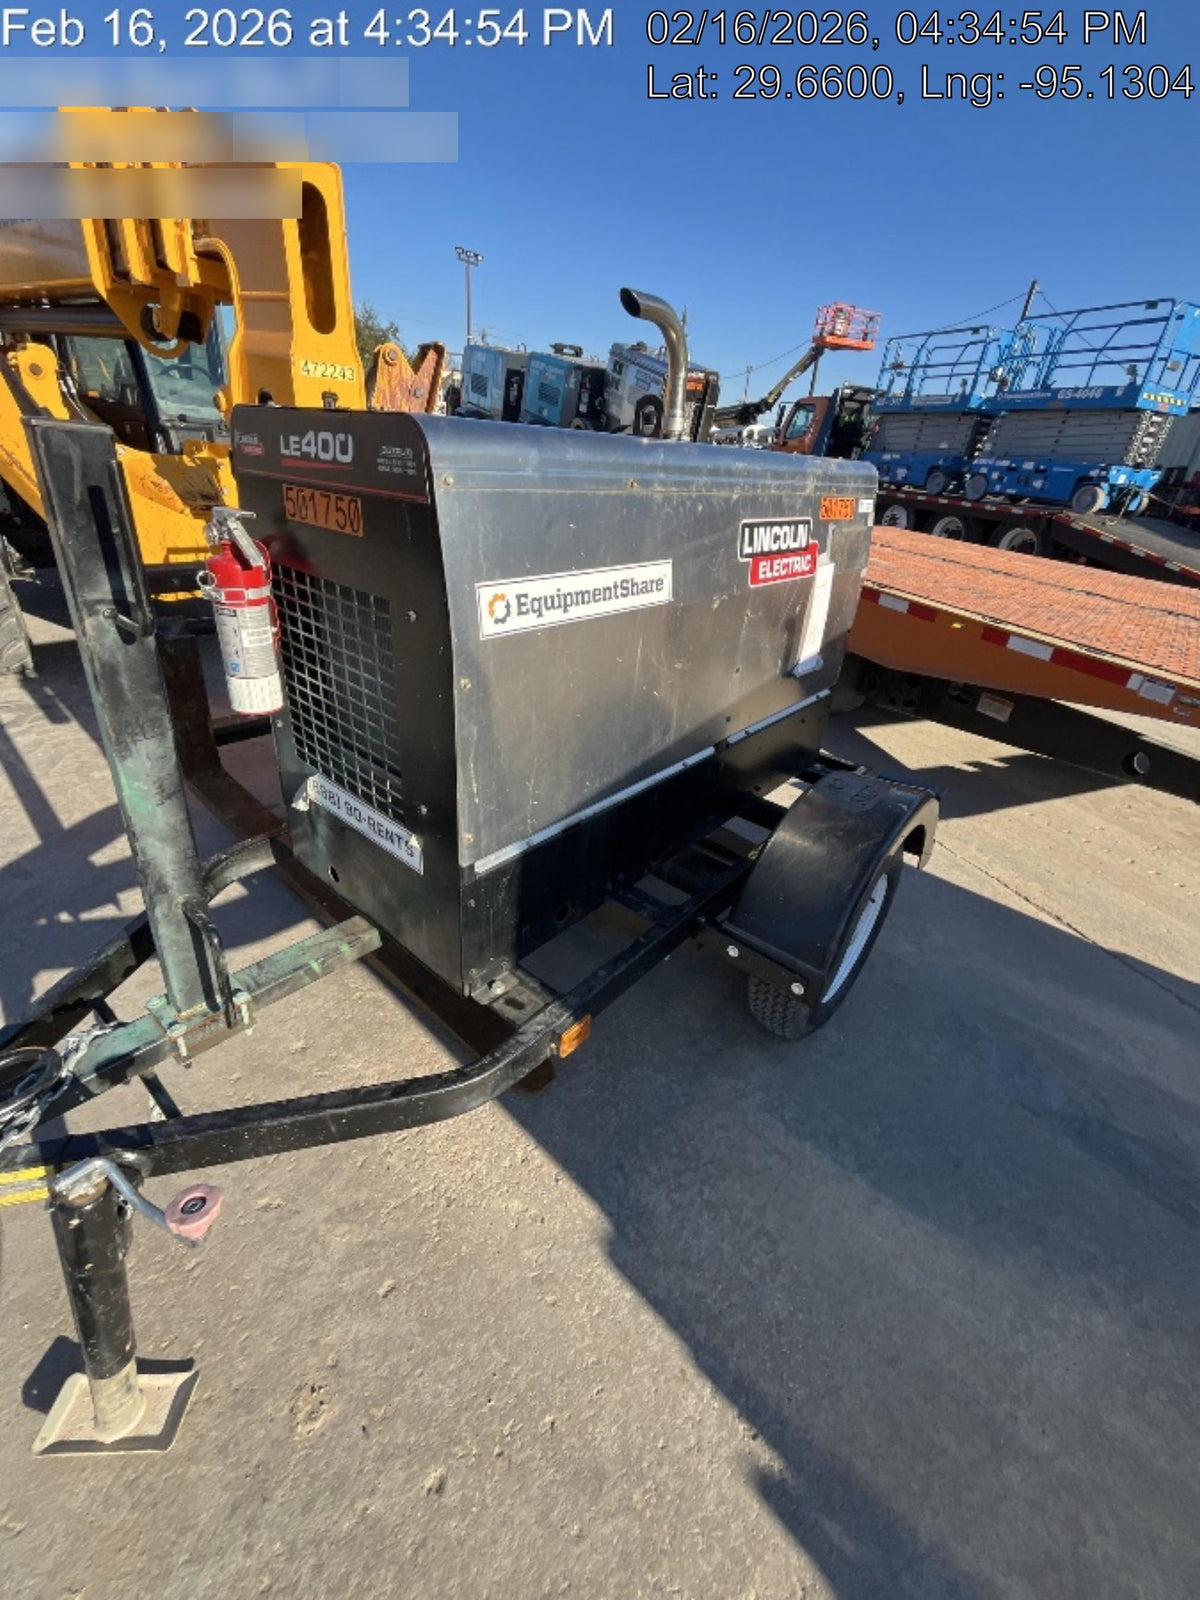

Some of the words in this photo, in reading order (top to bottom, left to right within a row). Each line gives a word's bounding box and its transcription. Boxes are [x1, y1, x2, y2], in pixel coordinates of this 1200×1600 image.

[280, 430, 354, 463] LE400
[285, 486, 362, 533] 501750
[742, 523, 809, 555] LINCOLN
[758, 554, 812, 580] ELECTRIC
[515, 577, 665, 618] EquipmentShare
